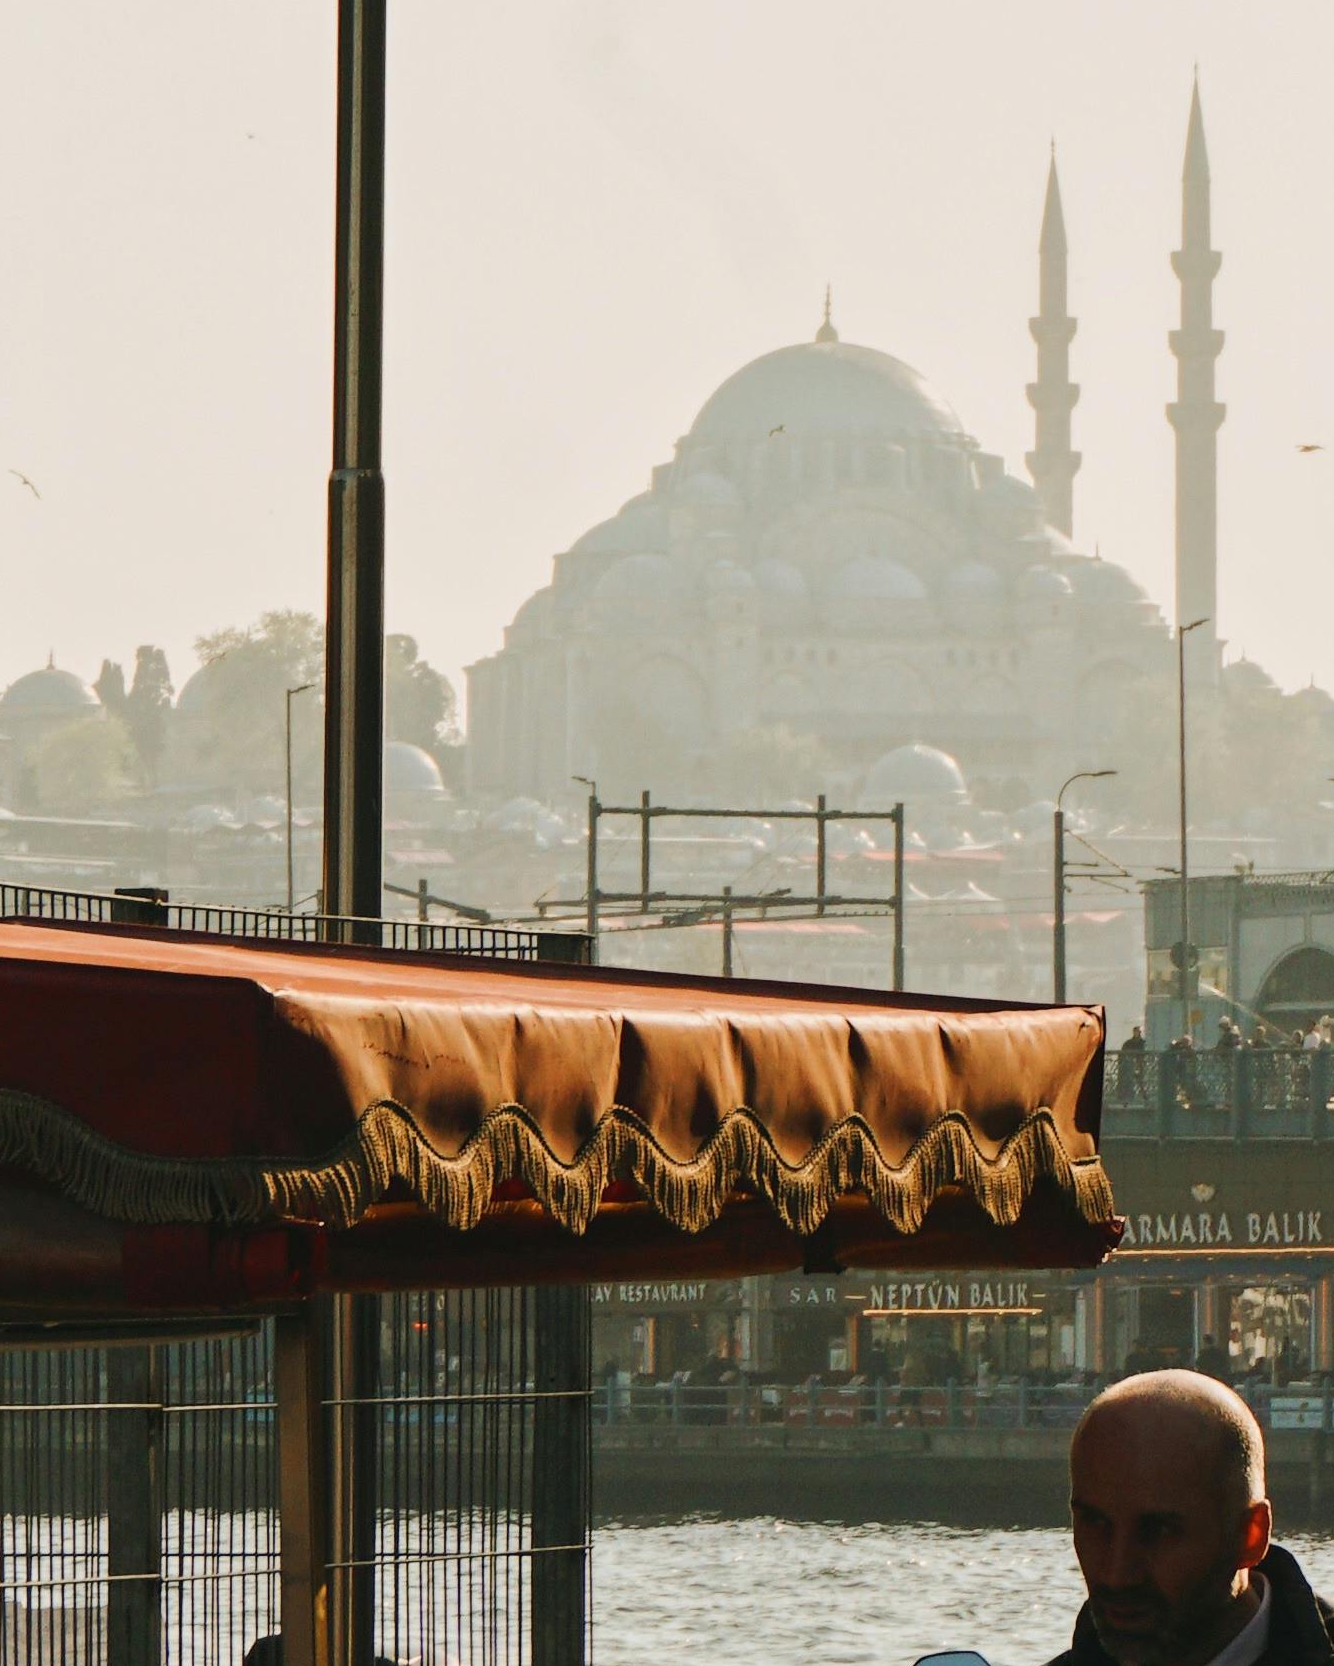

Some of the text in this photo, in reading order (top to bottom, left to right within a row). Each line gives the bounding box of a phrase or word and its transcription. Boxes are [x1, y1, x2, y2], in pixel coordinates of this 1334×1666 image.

[1120, 1211, 1323, 1244] ARMARA BALIK
[591, 1283, 707, 1303] AY RESTAURANT
[789, 1287, 837, 1304] SAR
[870, 1280, 1028, 1310] NEPTÜN BALIK
